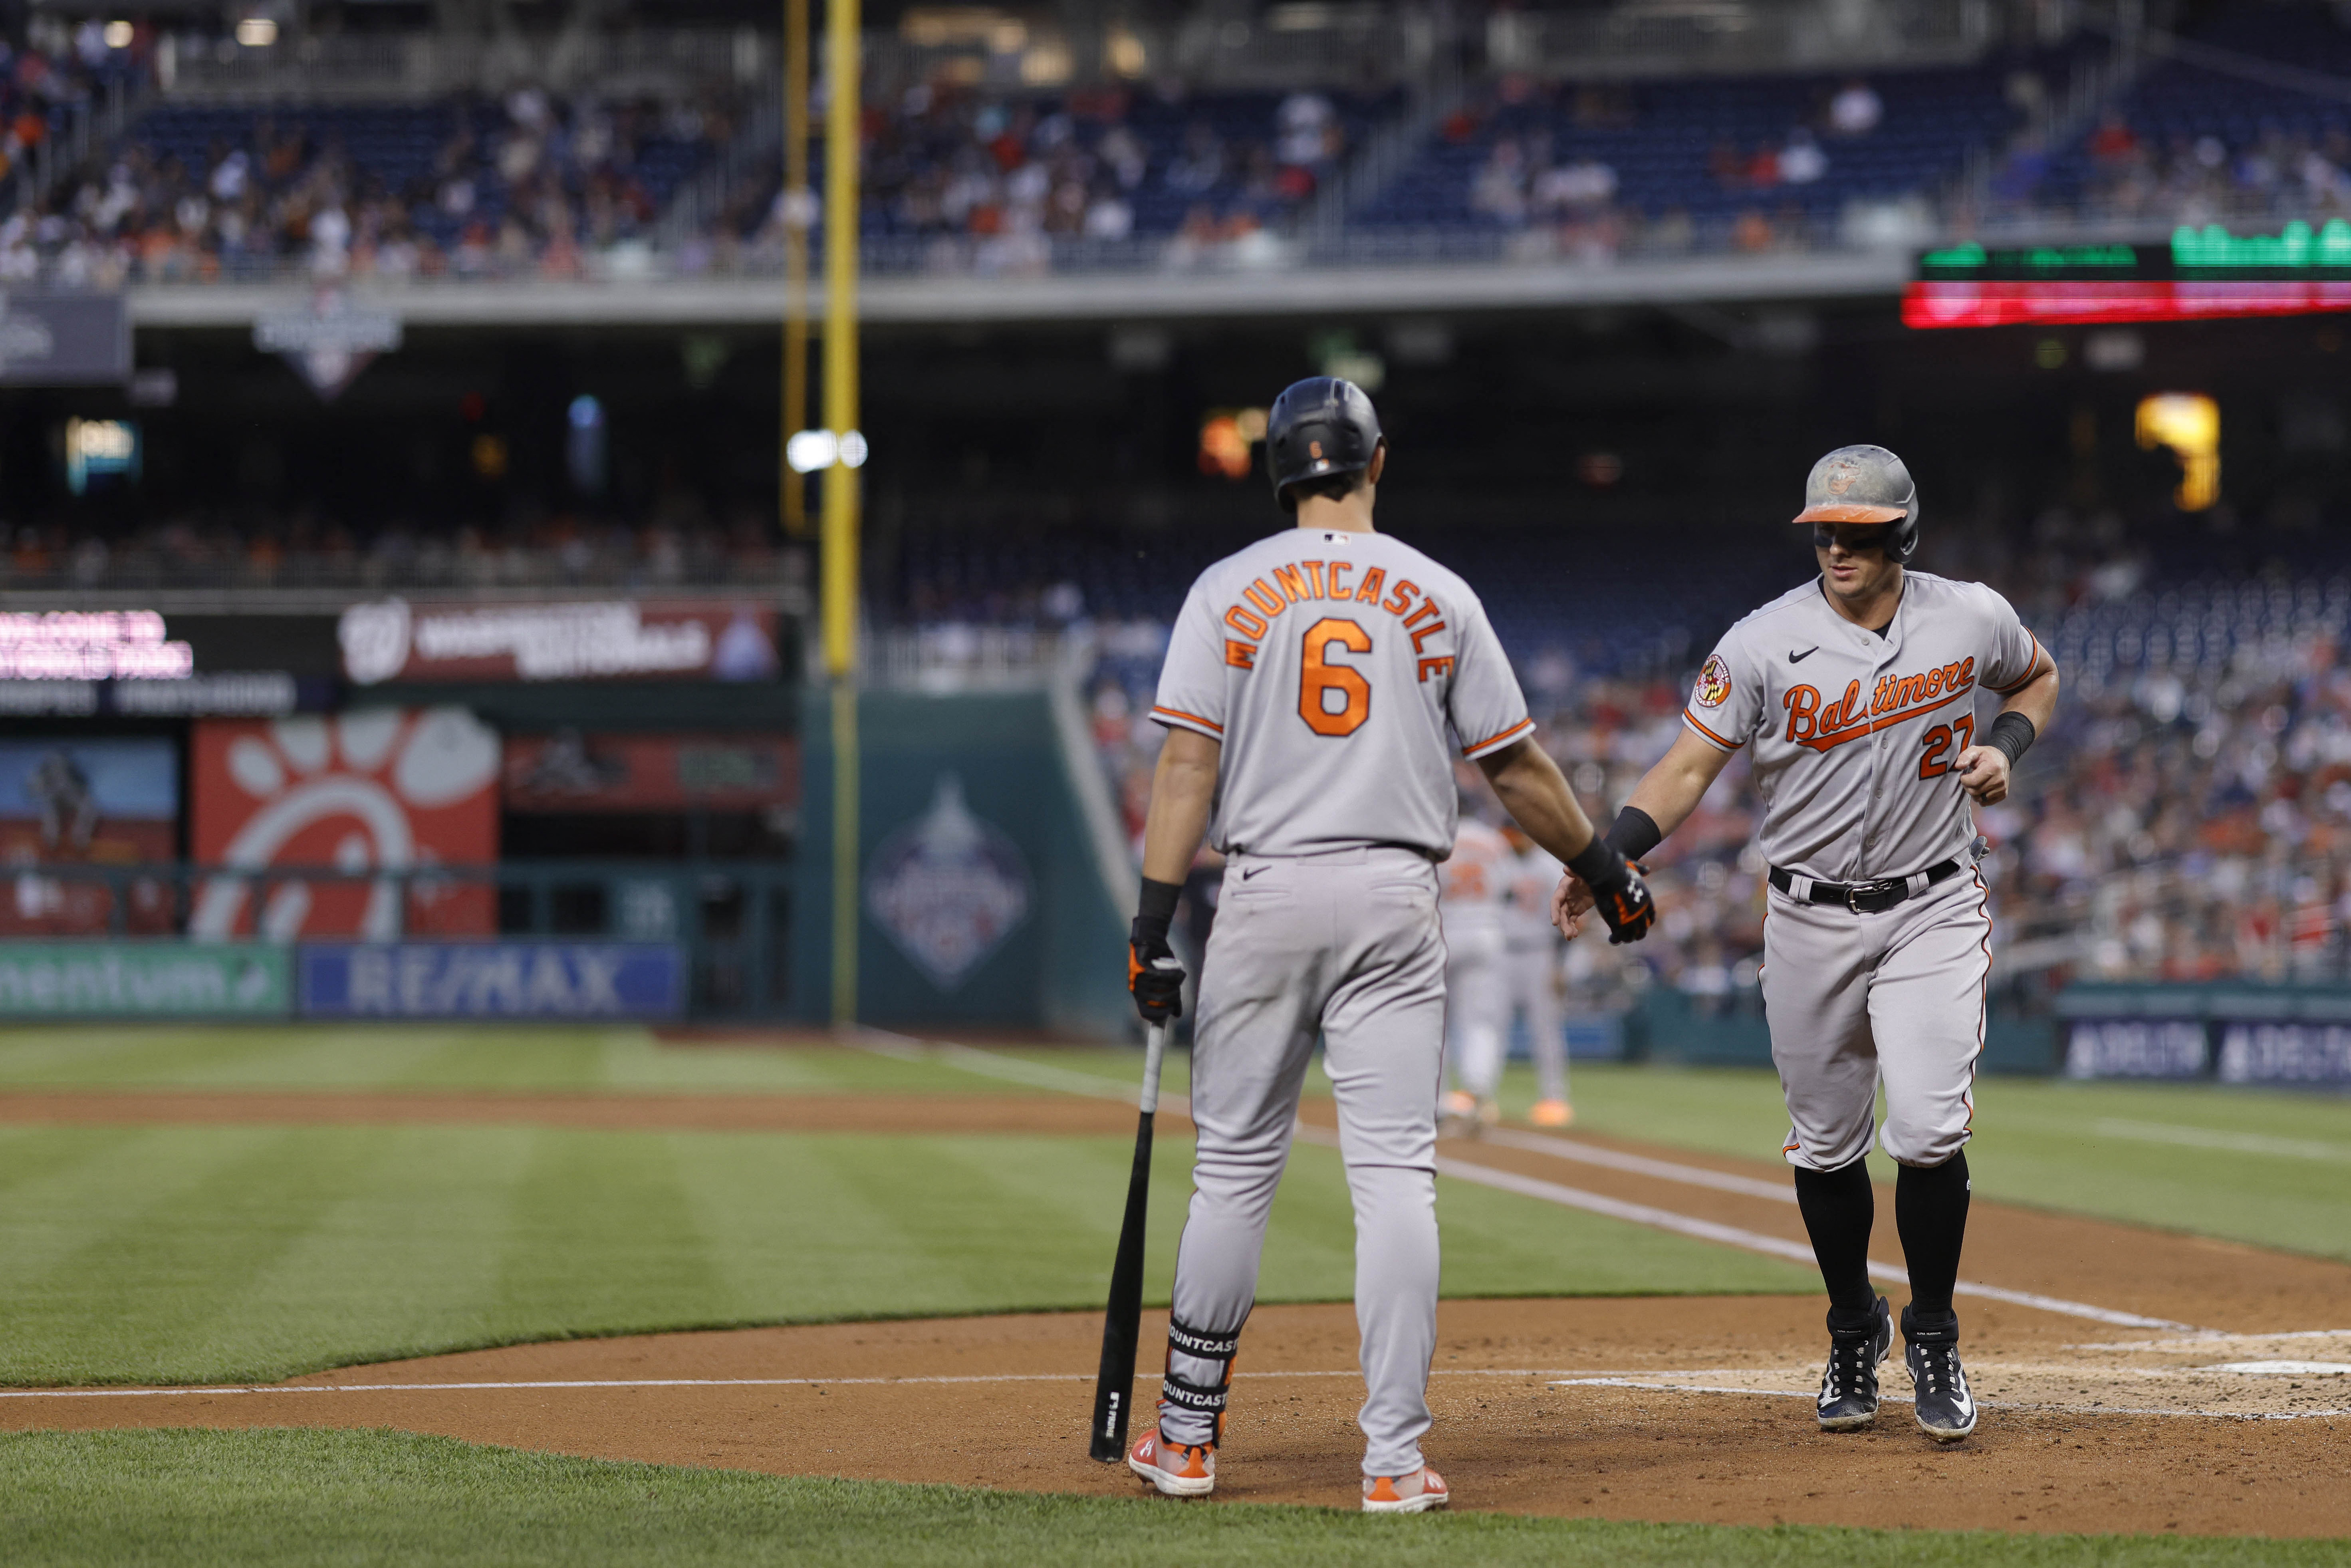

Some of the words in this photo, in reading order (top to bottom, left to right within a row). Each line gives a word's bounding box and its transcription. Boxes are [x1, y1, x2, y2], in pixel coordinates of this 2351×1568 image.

[1224, 560, 1455, 683] MOUNTCASTLE
[1298, 617, 1371, 736] 6
[1784, 656, 1975, 743] Baltimore
[1918, 712, 1974, 780] 27
[347, 947, 621, 1014] RE/MAX
[1169, 1323, 1238, 1353] OUNTCAST
